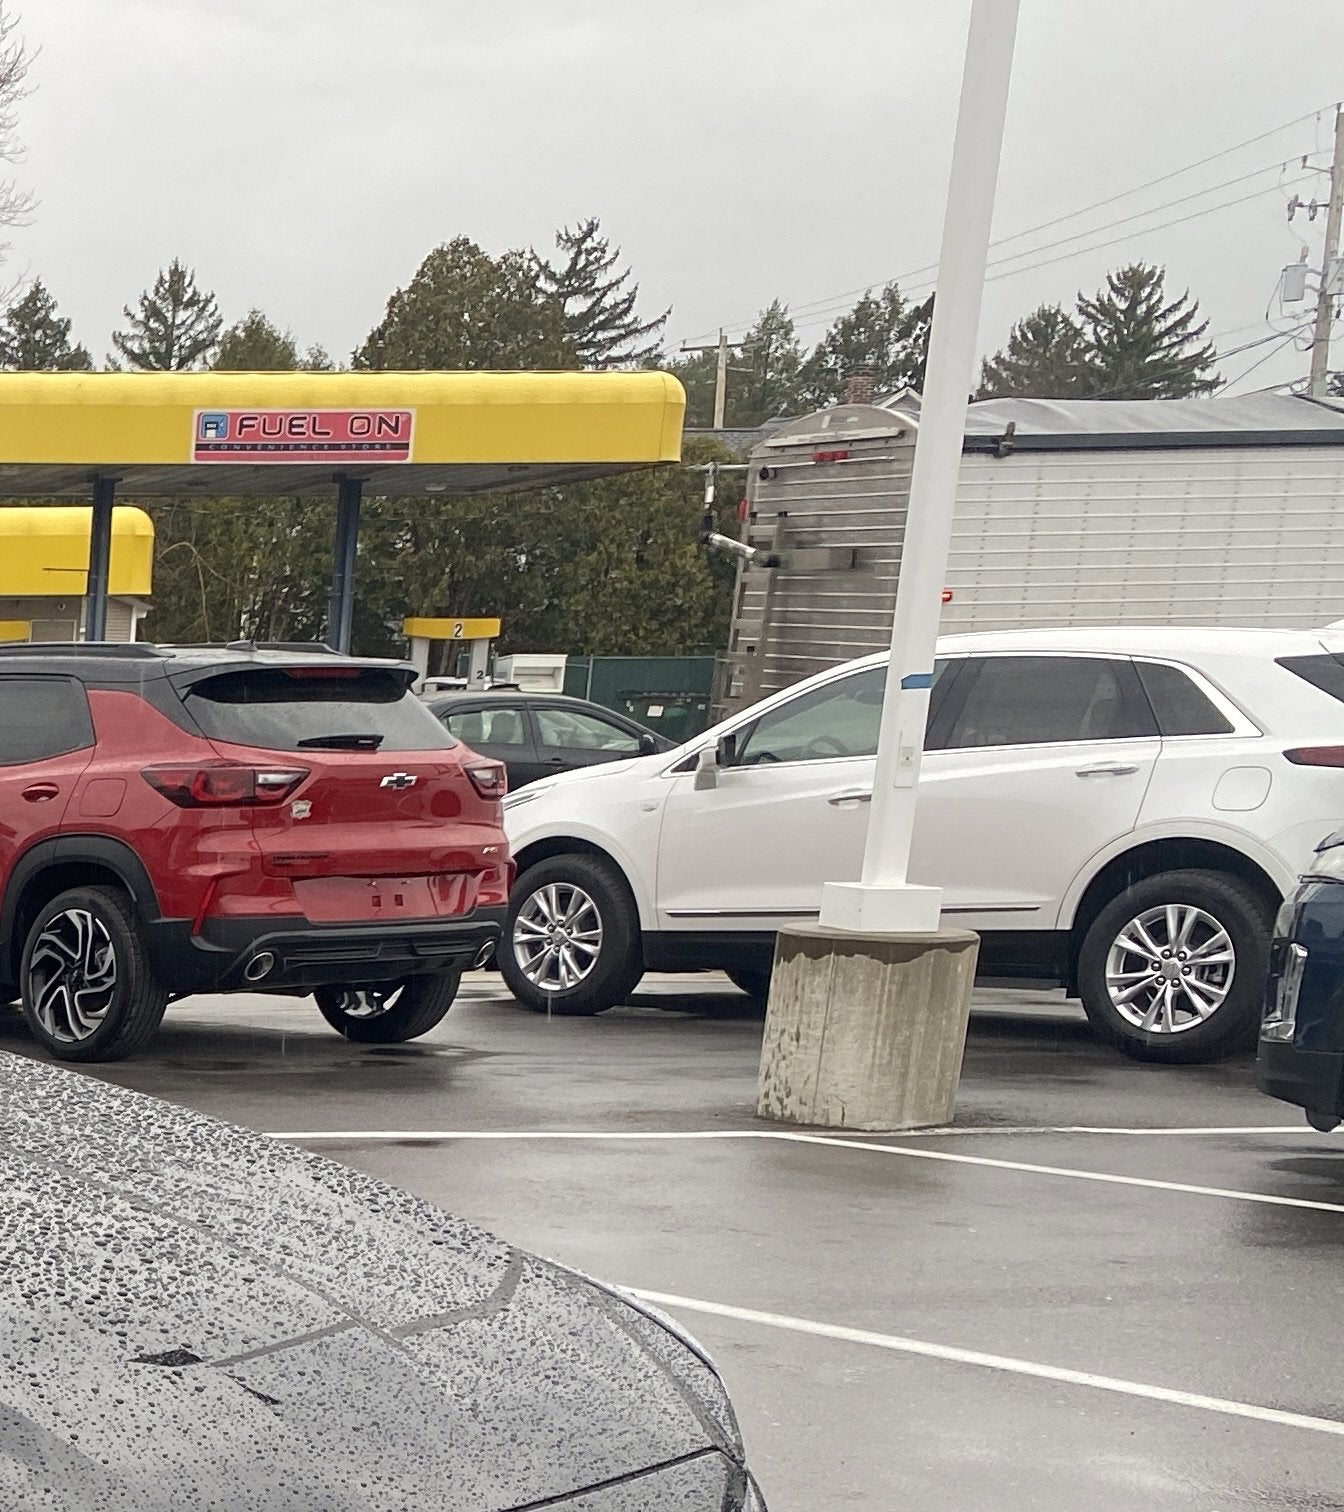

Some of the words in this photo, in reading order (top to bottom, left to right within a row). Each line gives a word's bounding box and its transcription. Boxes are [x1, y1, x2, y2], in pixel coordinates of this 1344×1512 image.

[237, 415, 331, 436] FUEL
[349, 415, 400, 435] ON
[454, 623, 464, 638] 2
[476, 670, 485, 680] 2
